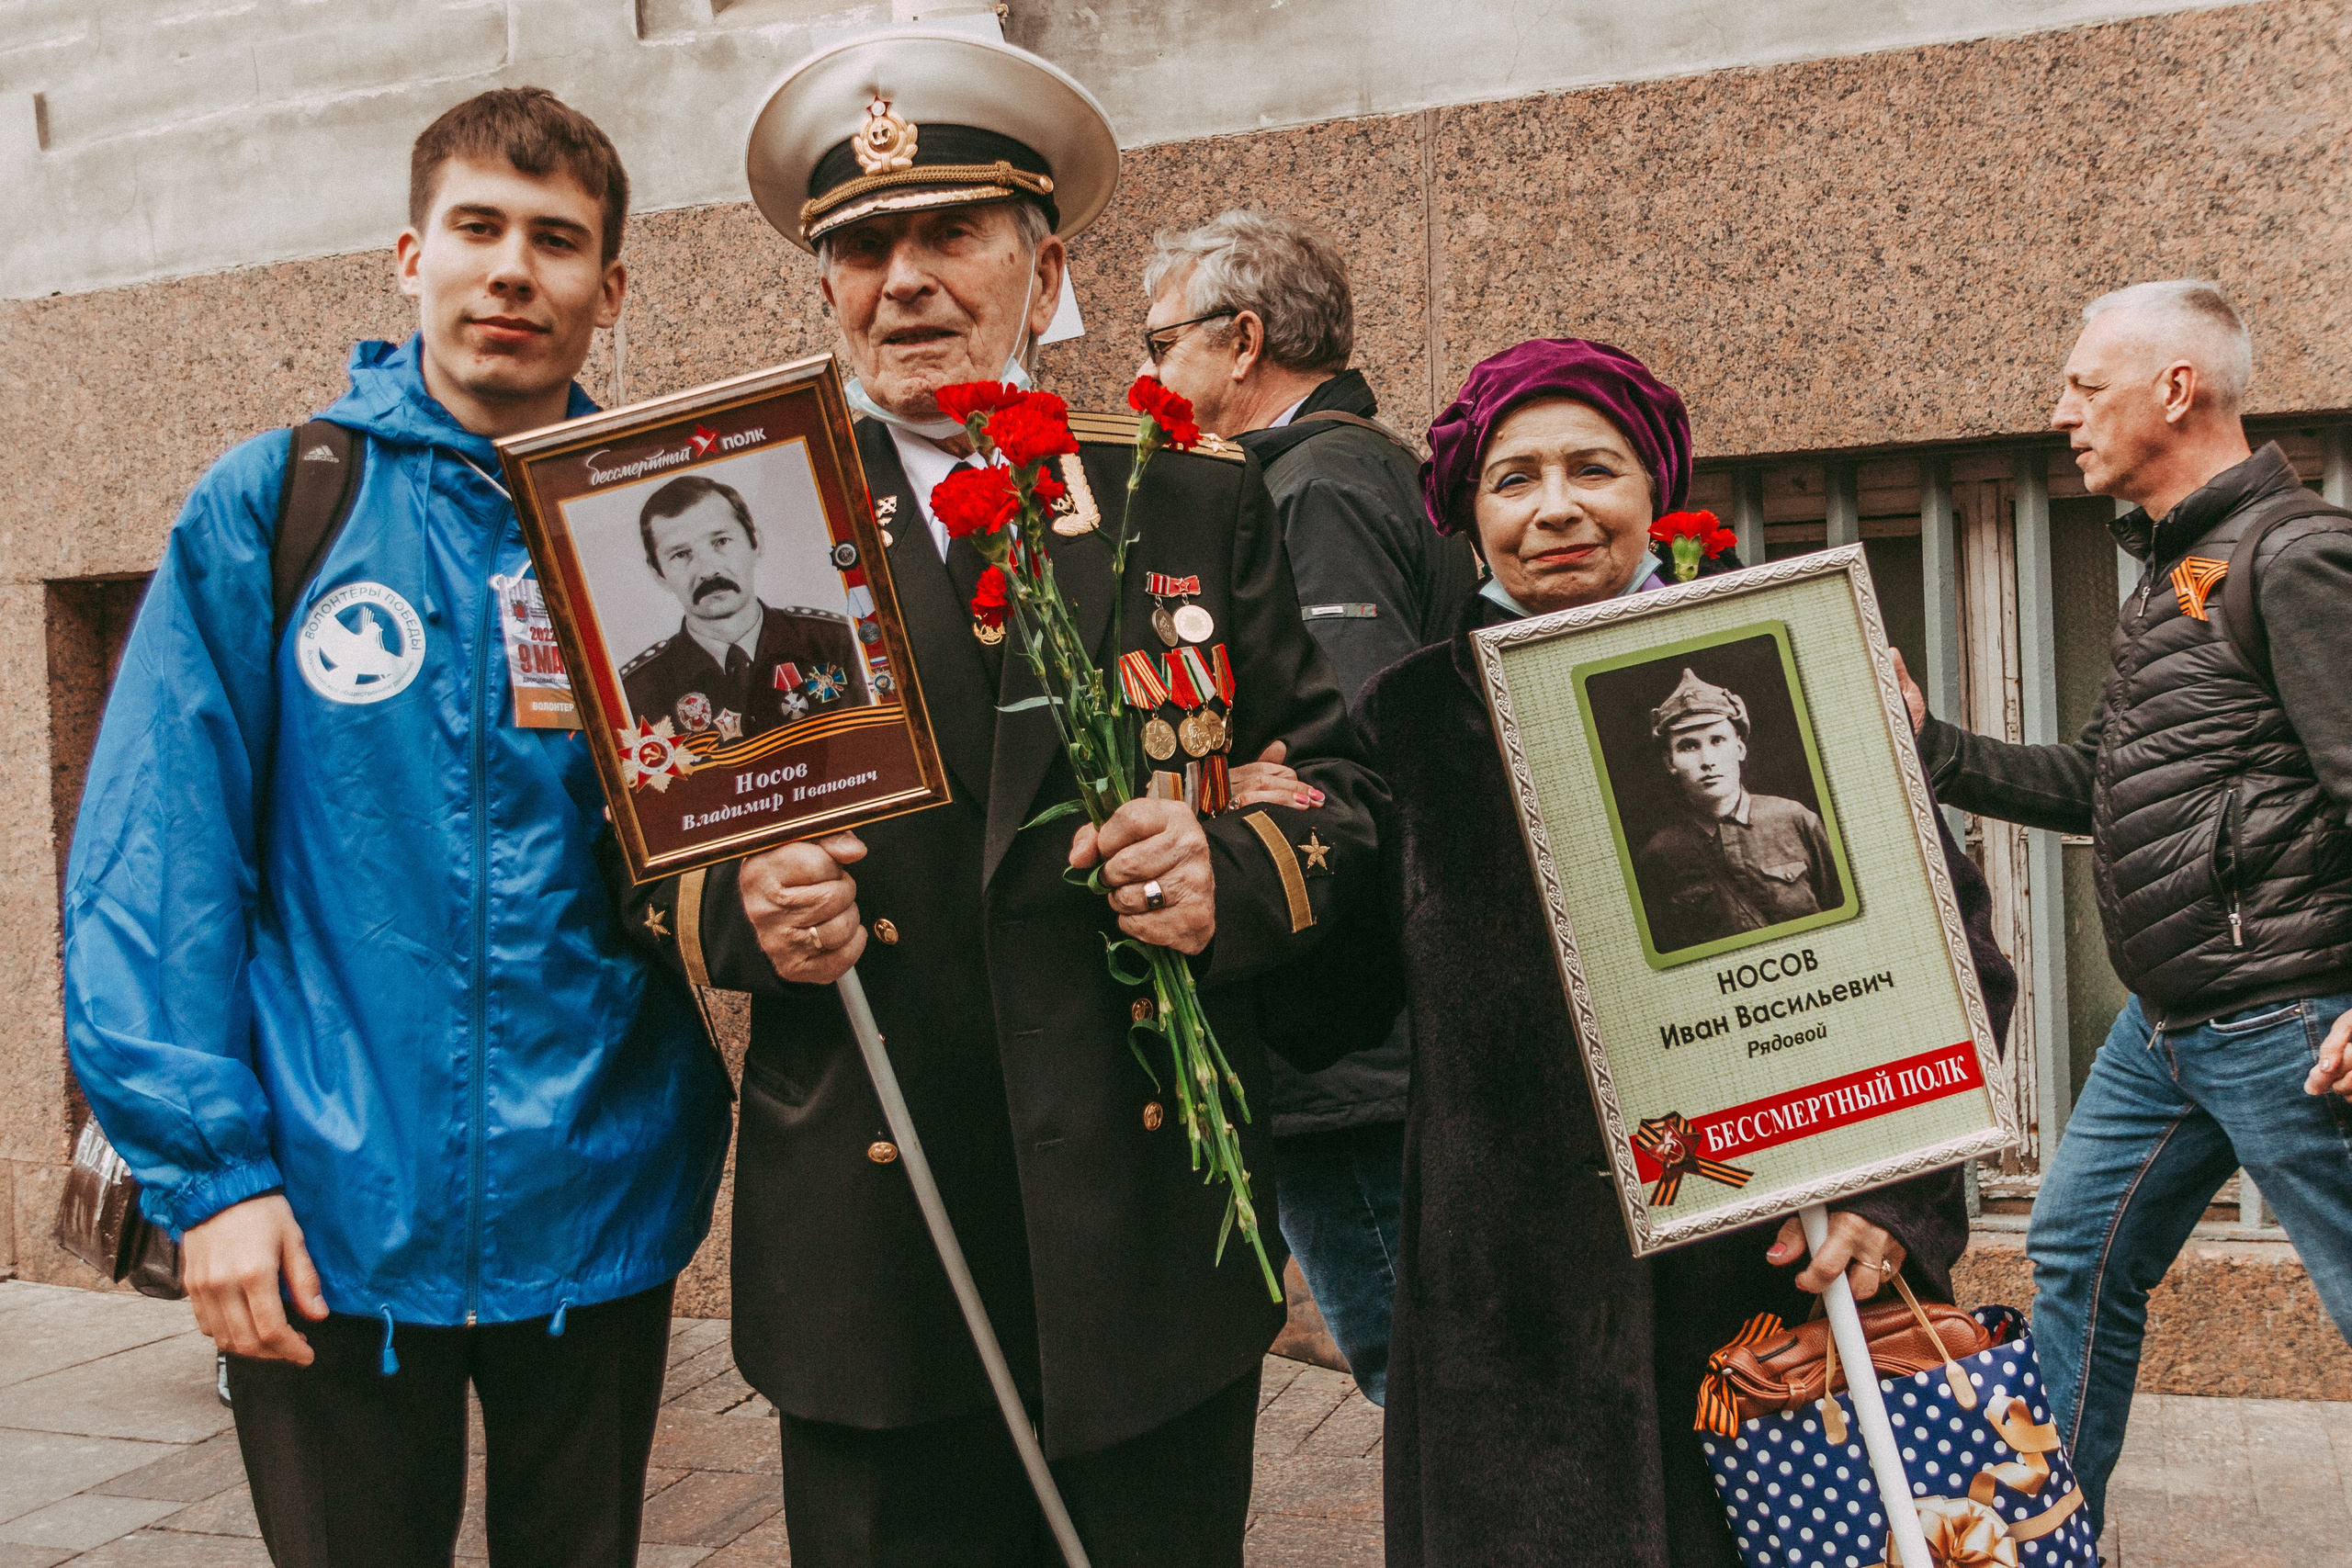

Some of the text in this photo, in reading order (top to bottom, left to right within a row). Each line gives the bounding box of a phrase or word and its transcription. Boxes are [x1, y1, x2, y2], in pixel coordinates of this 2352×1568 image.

[304, 454, 340, 464] adidas
[305, 586, 422, 650] ВОЛОНТЁРЫ ПОБЕДЫ
[517, 644, 567, 675] 9 МА
[531, 701, 575, 712] ВОЛОНТЕР
[735, 761, 808, 795] Носов
[682, 770, 878, 831] Владимир Иванович
[1716, 948, 1819, 995] НОСОВ
[1659, 970, 1894, 1050] Иван Васильевич
[1747, 1021, 1827, 1058] Рядовой
[1704, 1055, 1969, 1153] БЕССМЕРТНЫЙ ПОЛК
